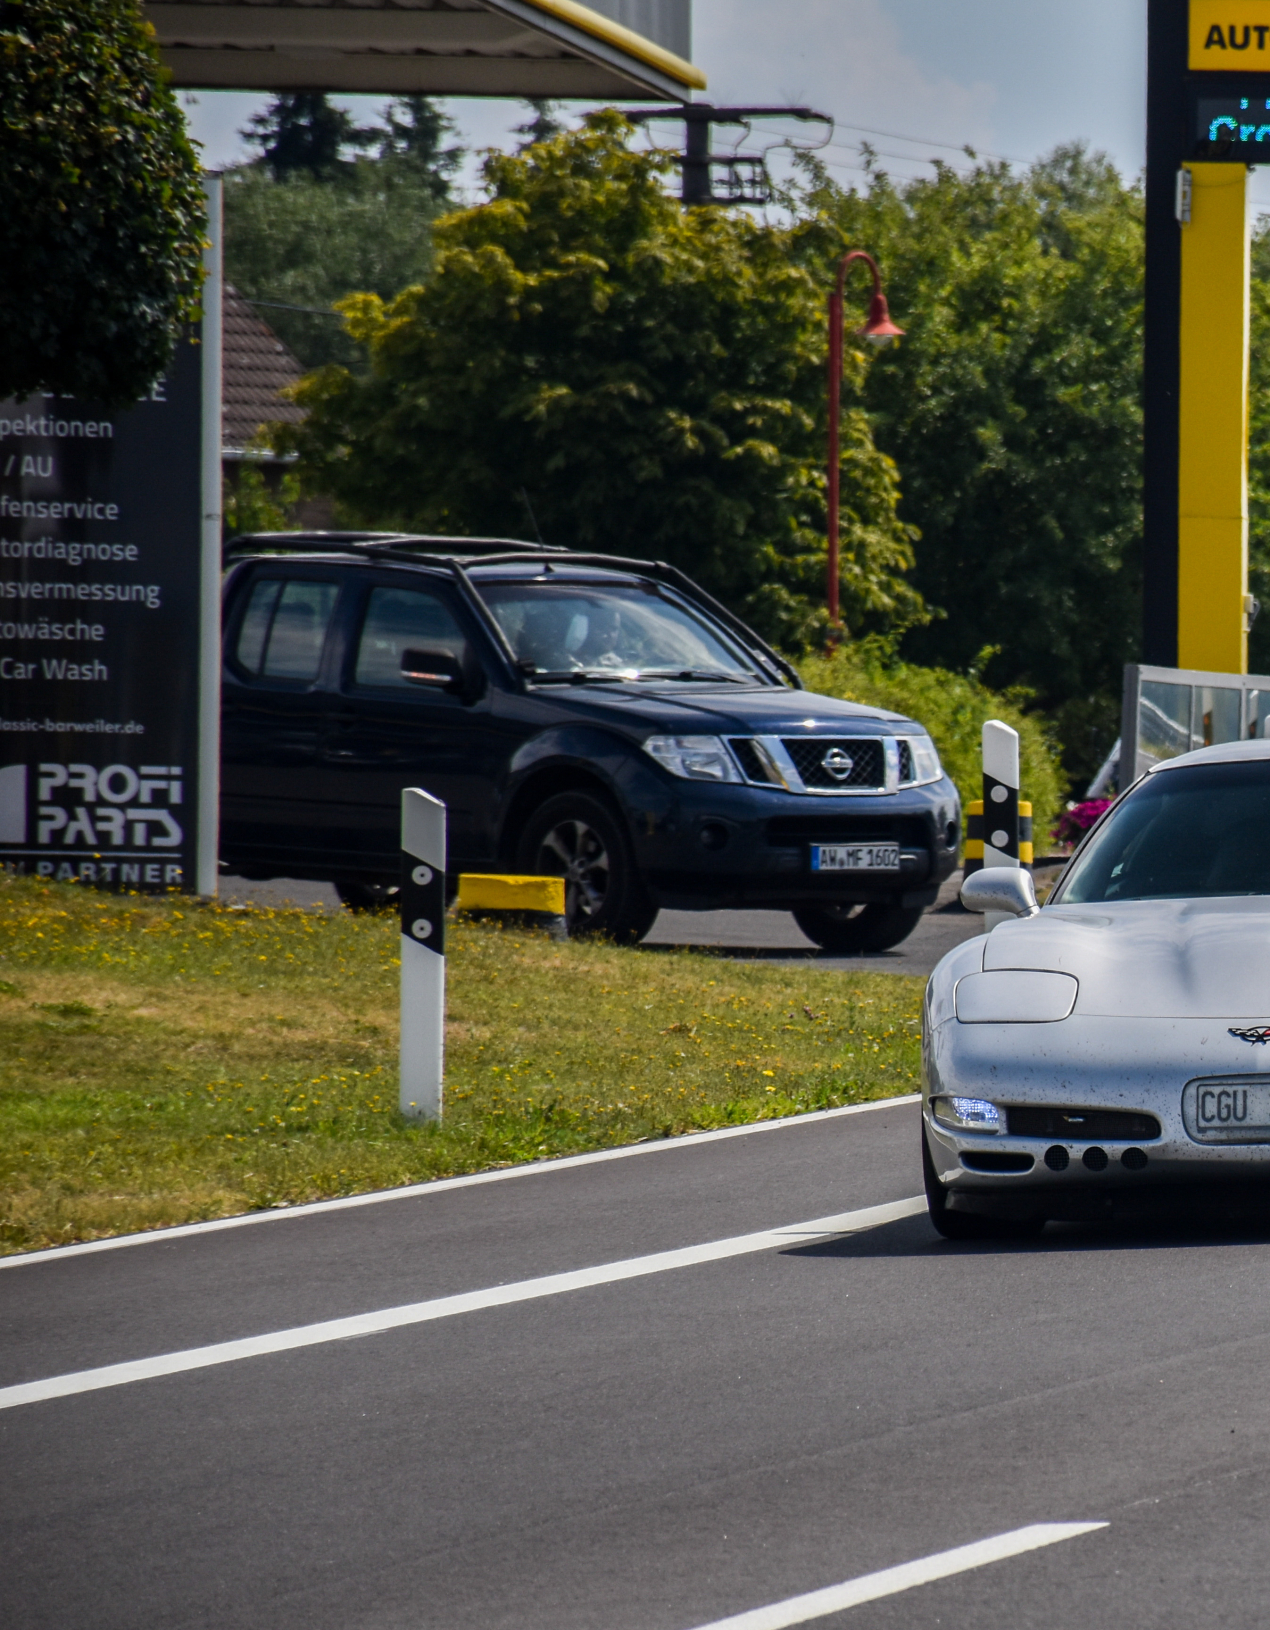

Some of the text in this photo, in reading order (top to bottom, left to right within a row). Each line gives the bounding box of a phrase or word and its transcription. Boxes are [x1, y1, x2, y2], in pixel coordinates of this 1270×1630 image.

[20, 455, 53, 478] AU
[1, 537, 138, 565] tordiagnose
[0, 657, 108, 681] Car Wash
[38, 763, 182, 804] PROFI
[38, 806, 183, 847] PARTS
[866, 848, 899, 868] 1602
[37, 861, 183, 883] PARTNER
[1200, 1090, 1248, 1123] CGU
